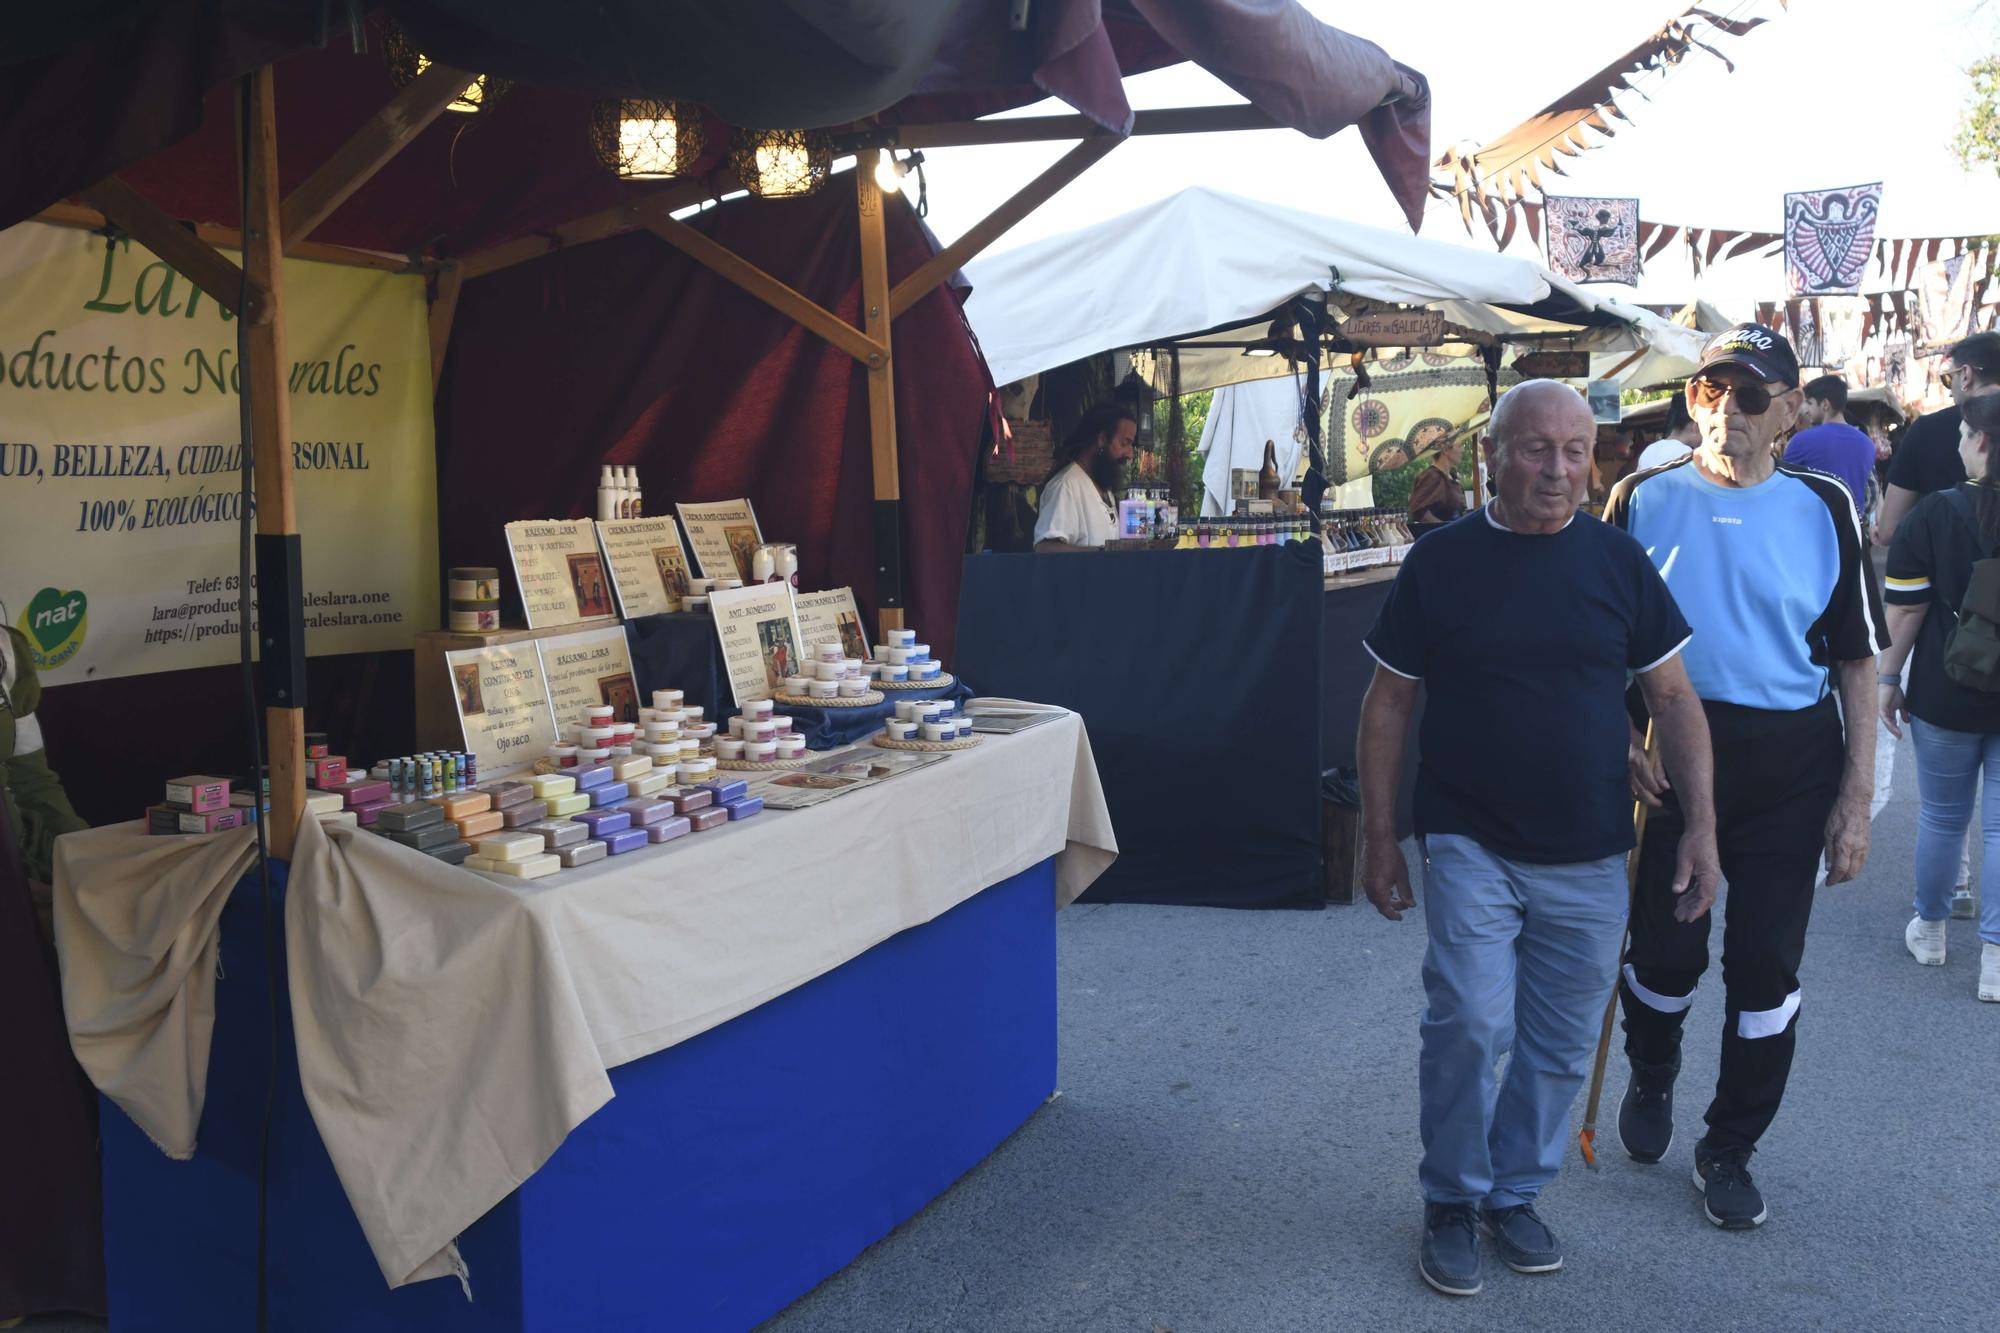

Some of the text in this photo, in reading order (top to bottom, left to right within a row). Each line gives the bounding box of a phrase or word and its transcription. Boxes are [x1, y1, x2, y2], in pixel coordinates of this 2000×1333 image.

[0, 330, 166, 393] ductos
[52, 444, 171, 483] BELLEZA,
[76, 499, 136, 532] 100%
[187, 577, 222, 595] Telef:
[35, 599, 81, 629] nat
[728, 608, 743, 619] ANTI
[723, 624, 737, 635] LARA
[591, 647, 610, 658] LARA
[497, 734, 530, 753] Ojo seco
